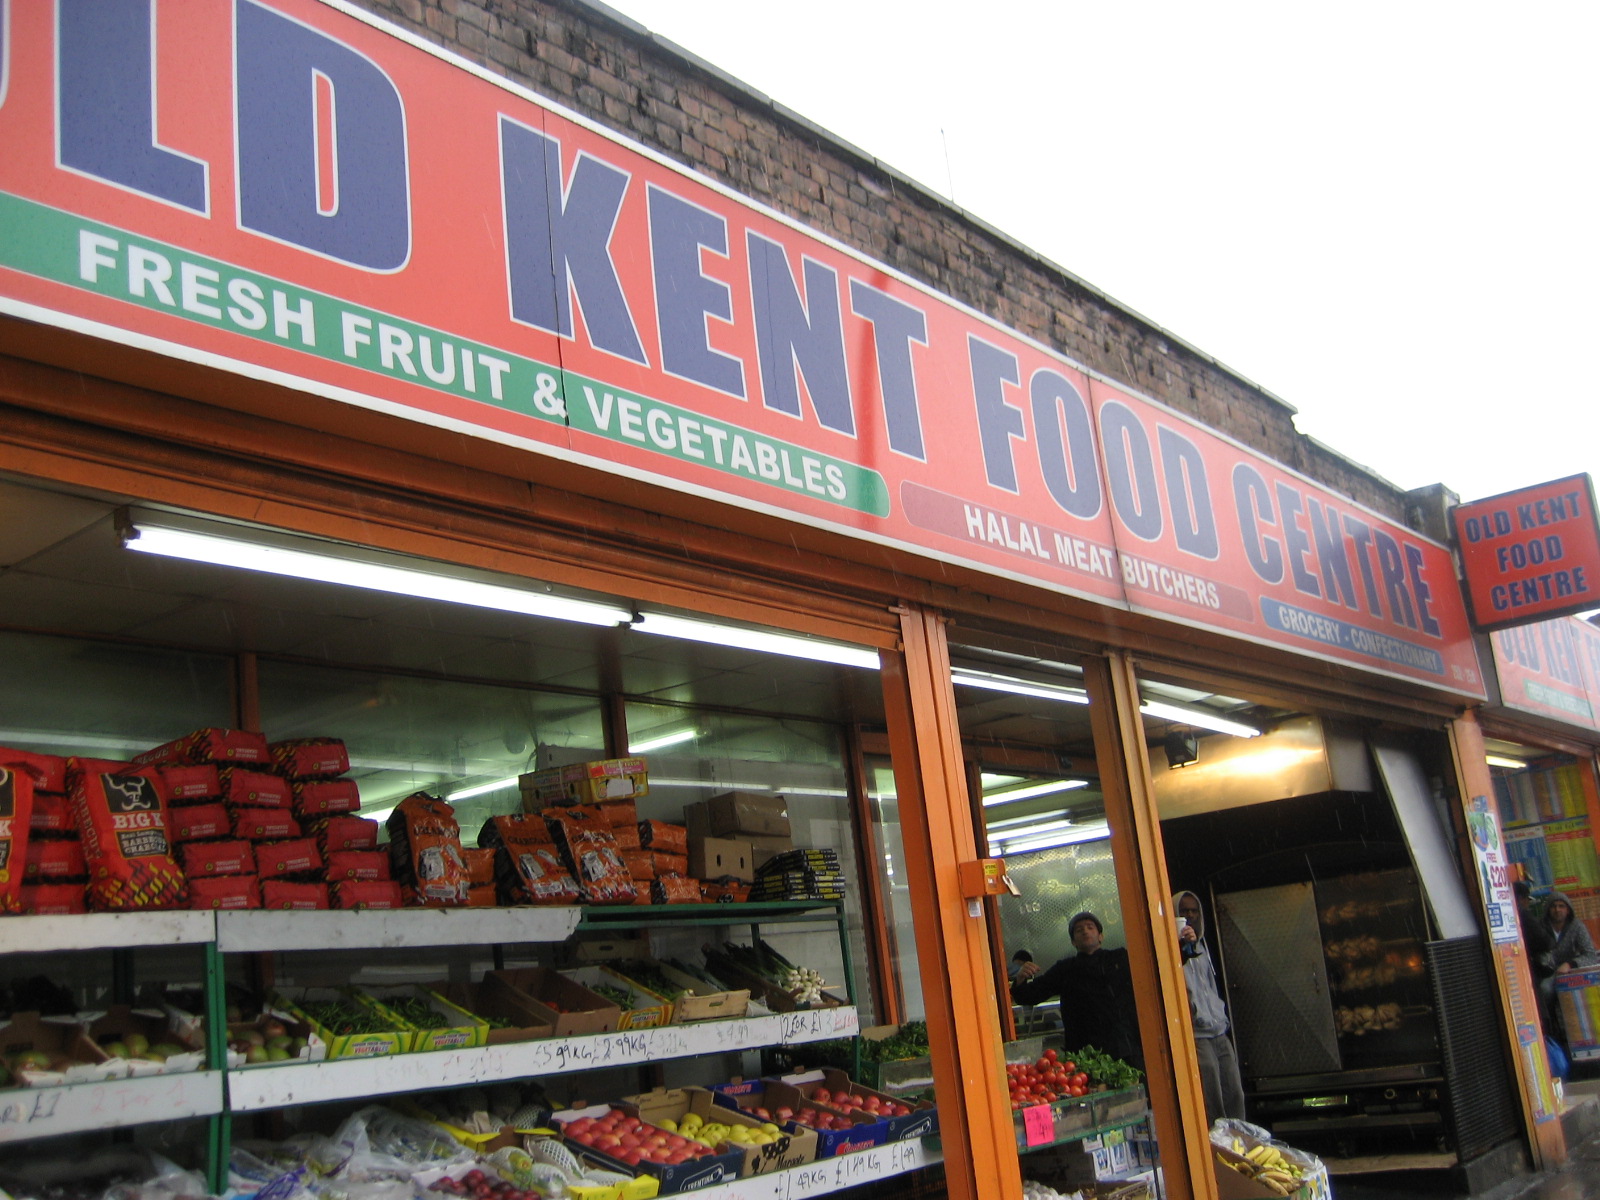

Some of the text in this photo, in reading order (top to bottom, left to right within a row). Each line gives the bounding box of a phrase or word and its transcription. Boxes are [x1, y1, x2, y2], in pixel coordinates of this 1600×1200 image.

[0, 0, 1443, 639] LD KENT FOOD CENTRE
[79, 229, 847, 500] FRESH FRUIT & VEGETABLES
[1464, 491, 1582, 543] OLD KENT
[963, 504, 1220, 610] HALAL MEAT BUTCHERS
[1496, 535, 1563, 572] FOOD
[1491, 566, 1589, 612] CENTRE
[1279, 606, 1342, 643] GROCERY
[1350, 628, 1438, 671] CONFECTIONARY
[112, 813, 151, 829] BIG
